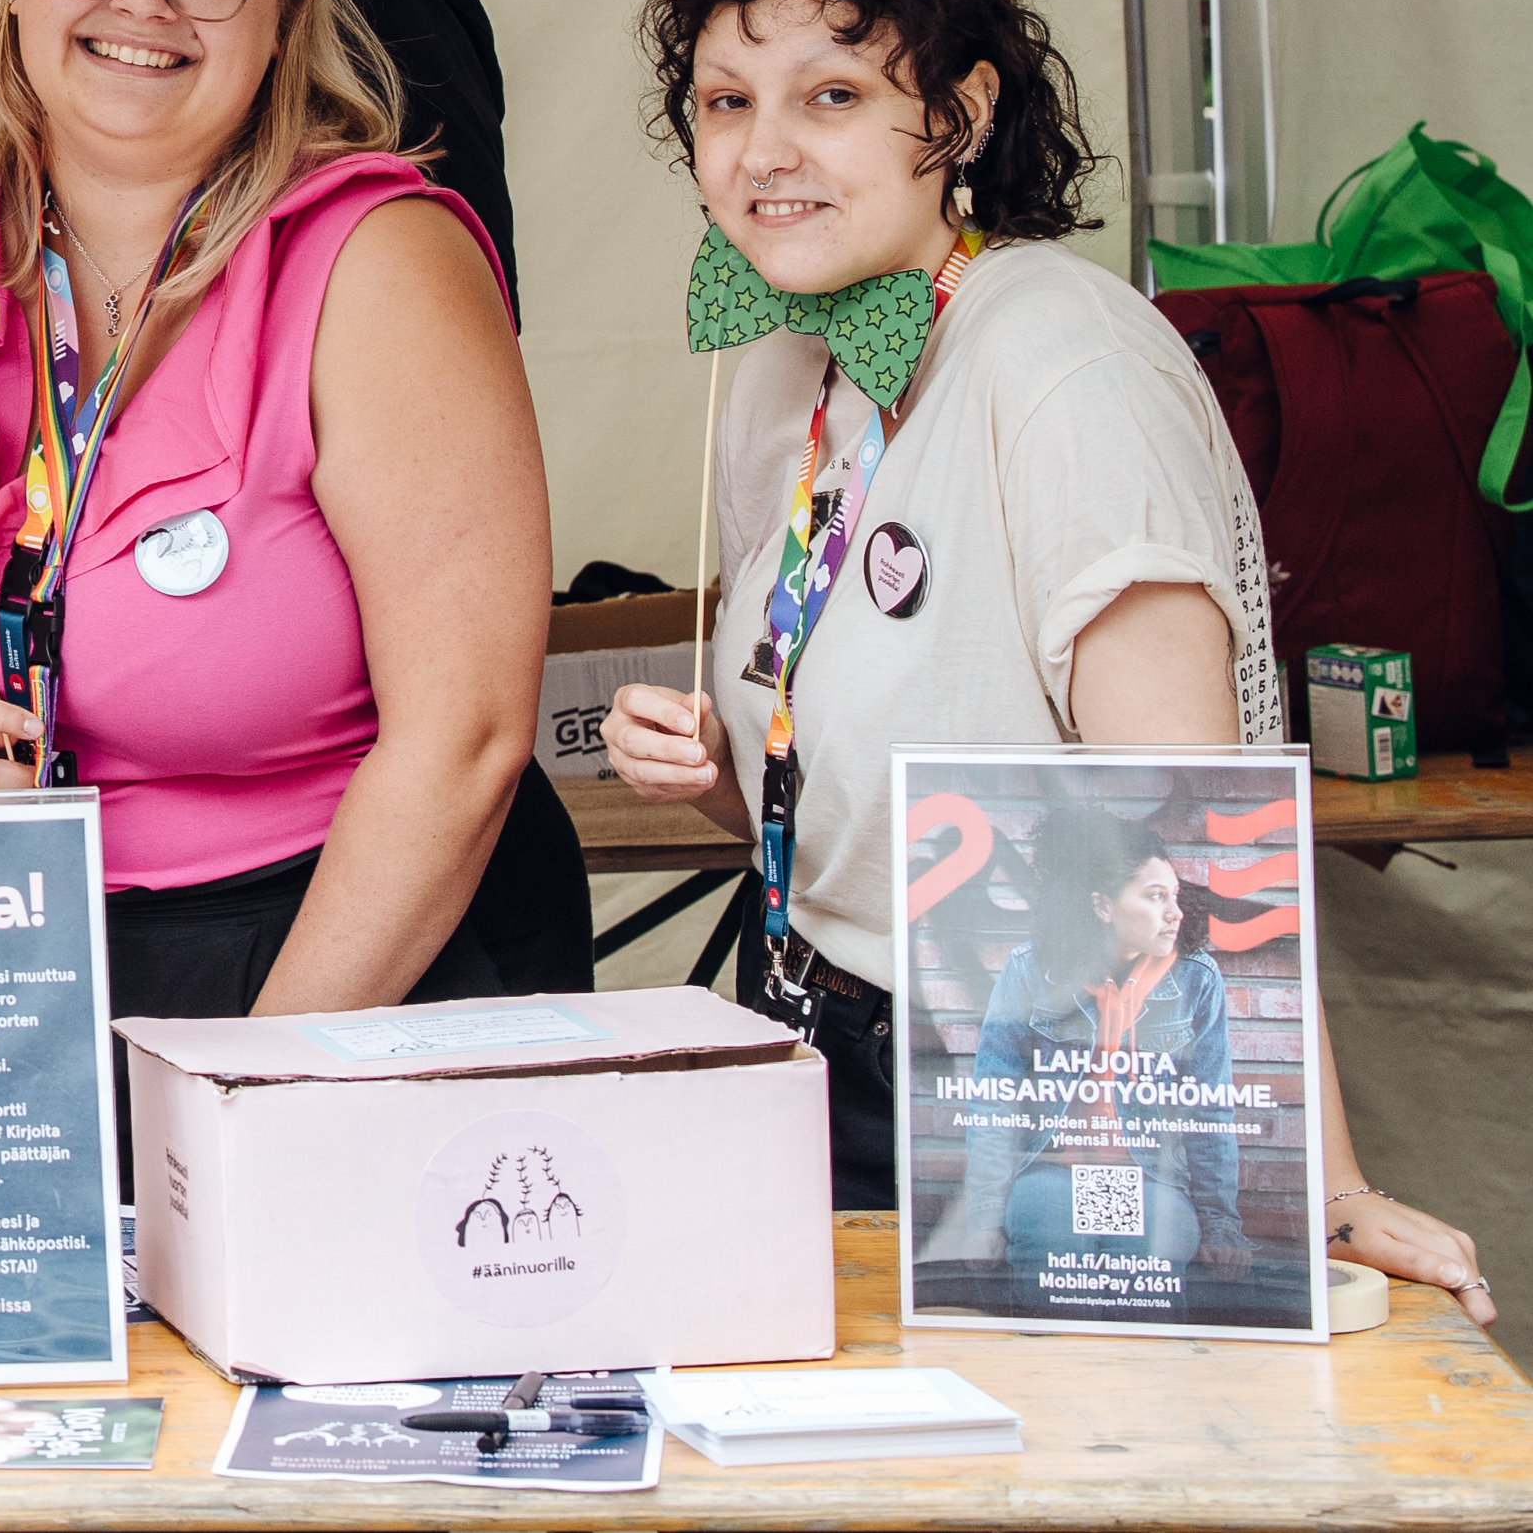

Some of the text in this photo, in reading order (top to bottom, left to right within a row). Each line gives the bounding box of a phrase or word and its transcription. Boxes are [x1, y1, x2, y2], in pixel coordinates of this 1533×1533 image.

[880, 558, 905, 579] Rohkeasti
[13, 969, 76, 982] muuttua
[1033, 1048, 1177, 1076] LAHJOITA
[936, 1074, 1278, 1109] IHMISARVOTYÖHÖMME.
[6, 1124, 61, 1141] Kirjoita
[952, 1112, 1261, 1135] Auta heitä, joiden ääni ei yhteiskunnassa
[1051, 1133, 1161, 1148] yleensä kuulu.
[1, 1146, 71, 1164] päättäjän
[25, 1214, 40, 1231] ja
[470, 1256, 576, 1281] #ääninuorille
[1047, 1252, 1172, 1274] hdl.fi/lahjoita
[1038, 1272, 1182, 1294] MobilePay 61611
[1049, 1295, 1116, 1306] Rahankeräyslupa
